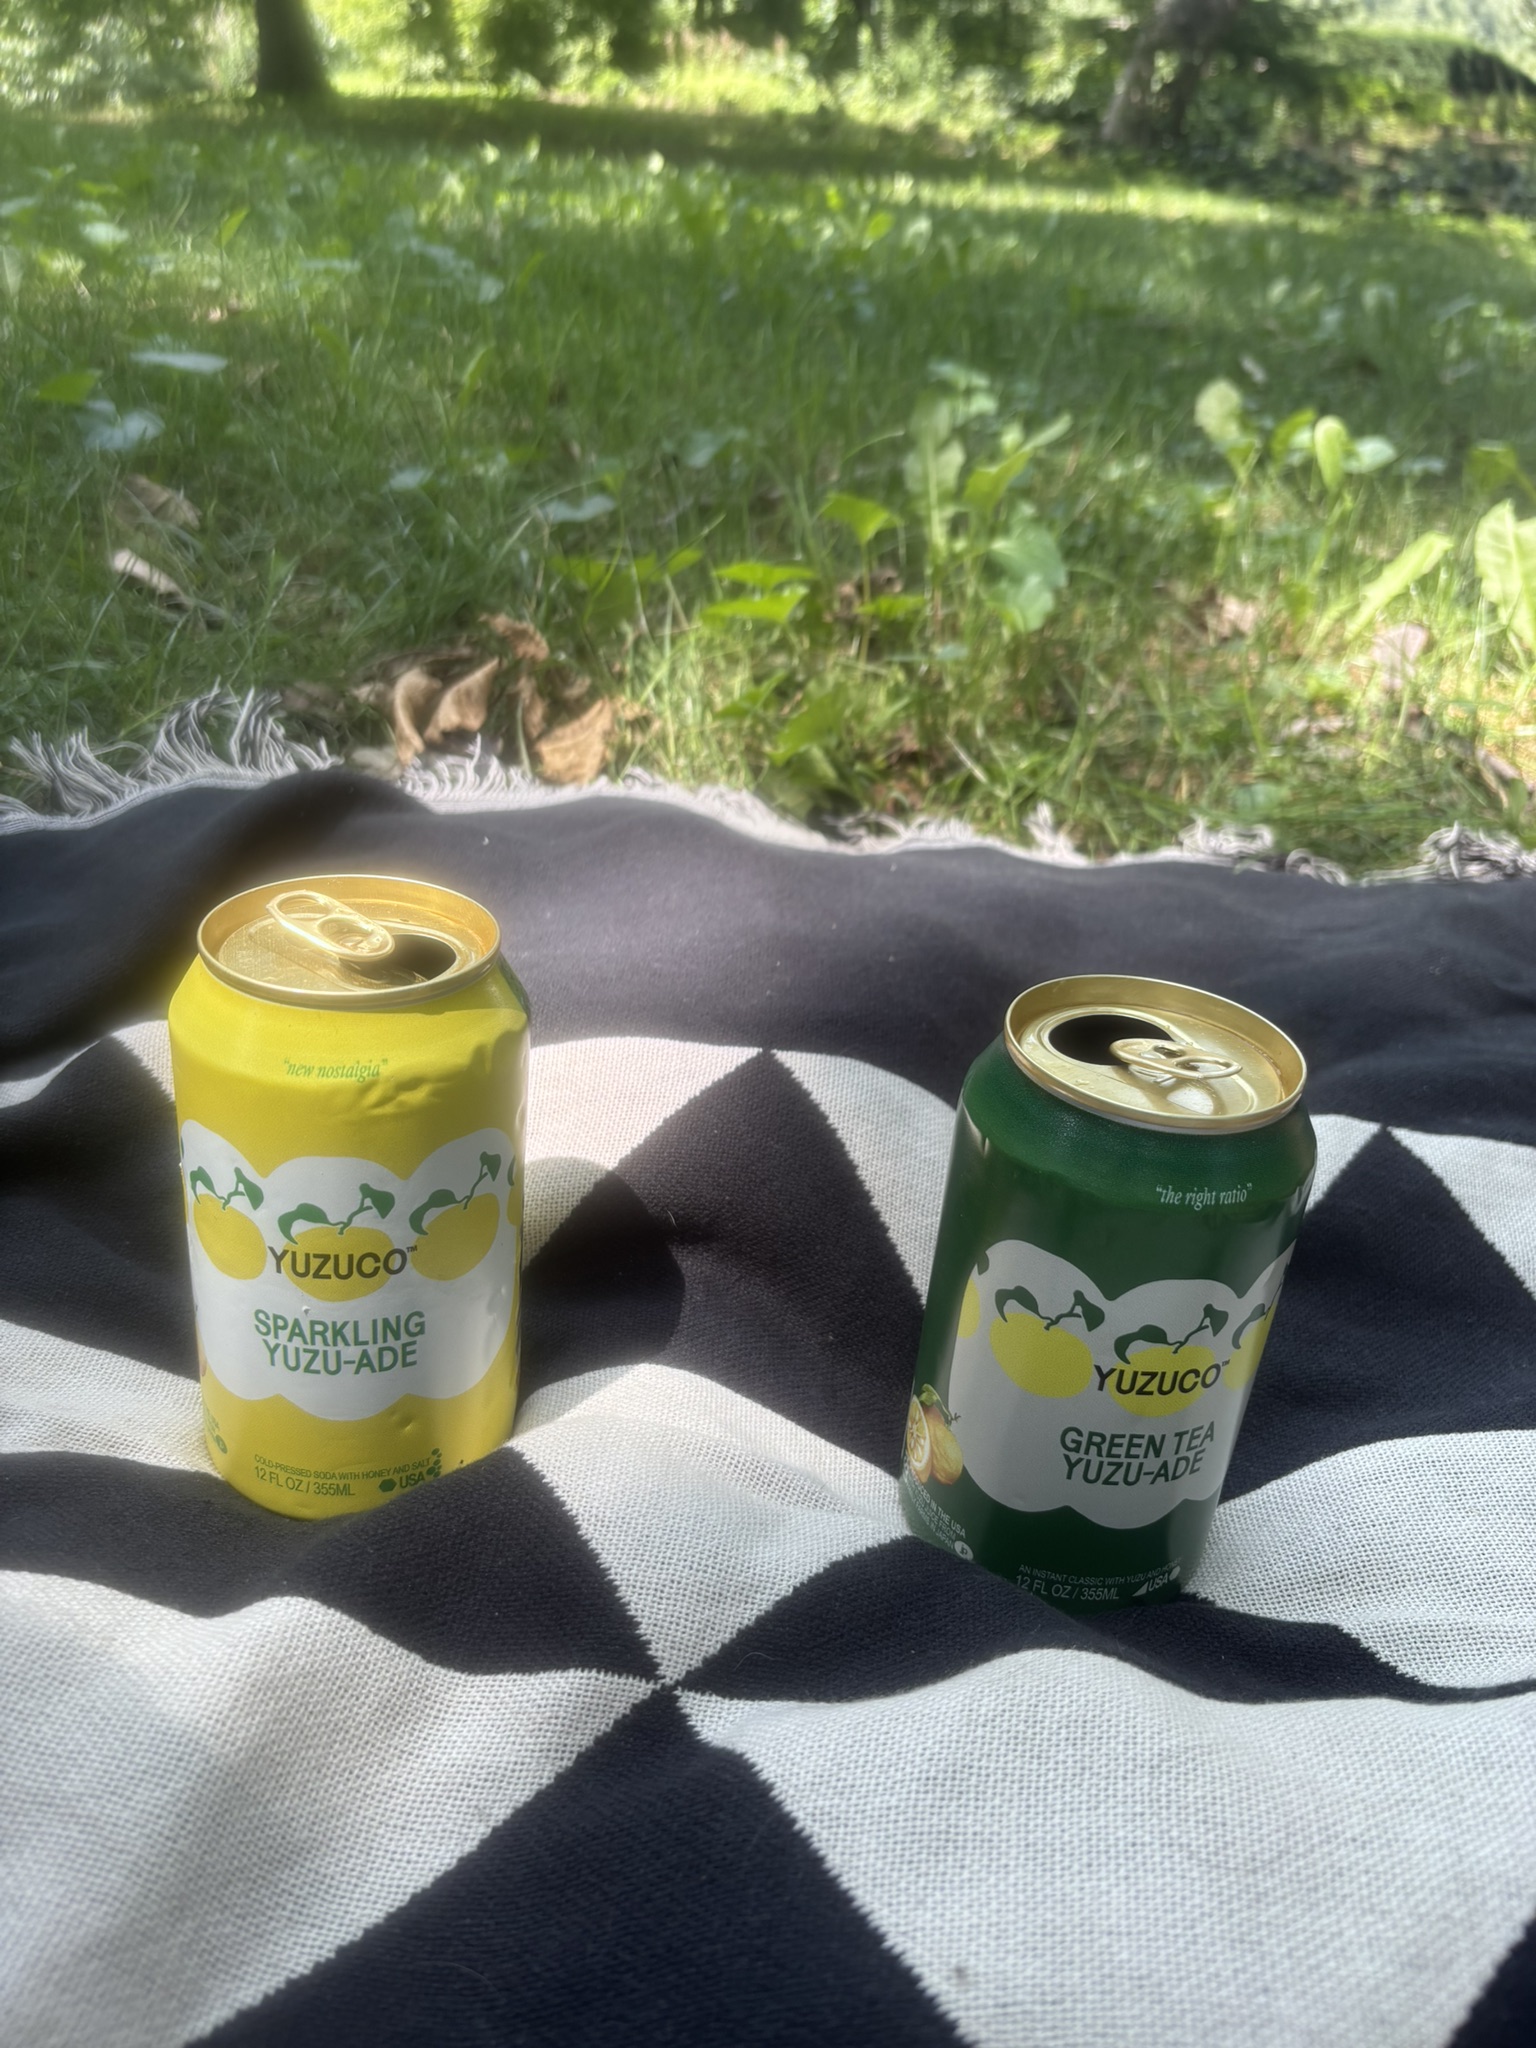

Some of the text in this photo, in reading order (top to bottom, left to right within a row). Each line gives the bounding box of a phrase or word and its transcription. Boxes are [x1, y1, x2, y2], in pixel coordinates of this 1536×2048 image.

[1185, 1187, 1216, 1211] right
[254, 1308, 426, 1347] SPARKLING
[262, 1338, 417, 1376] YUZU-ADE
[1060, 1420, 1215, 1459] GREEN TEA
[254, 1453, 431, 1481] COLD-PRESSED SODA WITH HONEY AND SALT
[255, 1465, 267, 1482] 12
[268, 1471, 284, 1488] FL
[285, 1476, 304, 1493] OZ
[313, 1481, 356, 1496] 355ML
[400, 1471, 425, 1489] USA
[1063, 1448, 1206, 1487] YUZU-ADE
[938, 1506, 951, 1526] THE
[951, 1519, 967, 1539] USA
[1016, 1575, 1031, 1590] 12
[1032, 1579, 1049, 1595] FL
[1051, 1583, 1072, 1599] OZ
[1080, 1587, 1120, 1601] 355ML
[1018, 1563, 1032, 1575] AN
[1032, 1567, 1068, 1583] INSTANT
[1068, 1574, 1104, 1586] CLASSIC
[1104, 1576, 1125, 1586] WITH
[1126, 1572, 1147, 1583] YUZU
[1148, 1572, 1169, 1592] USA
